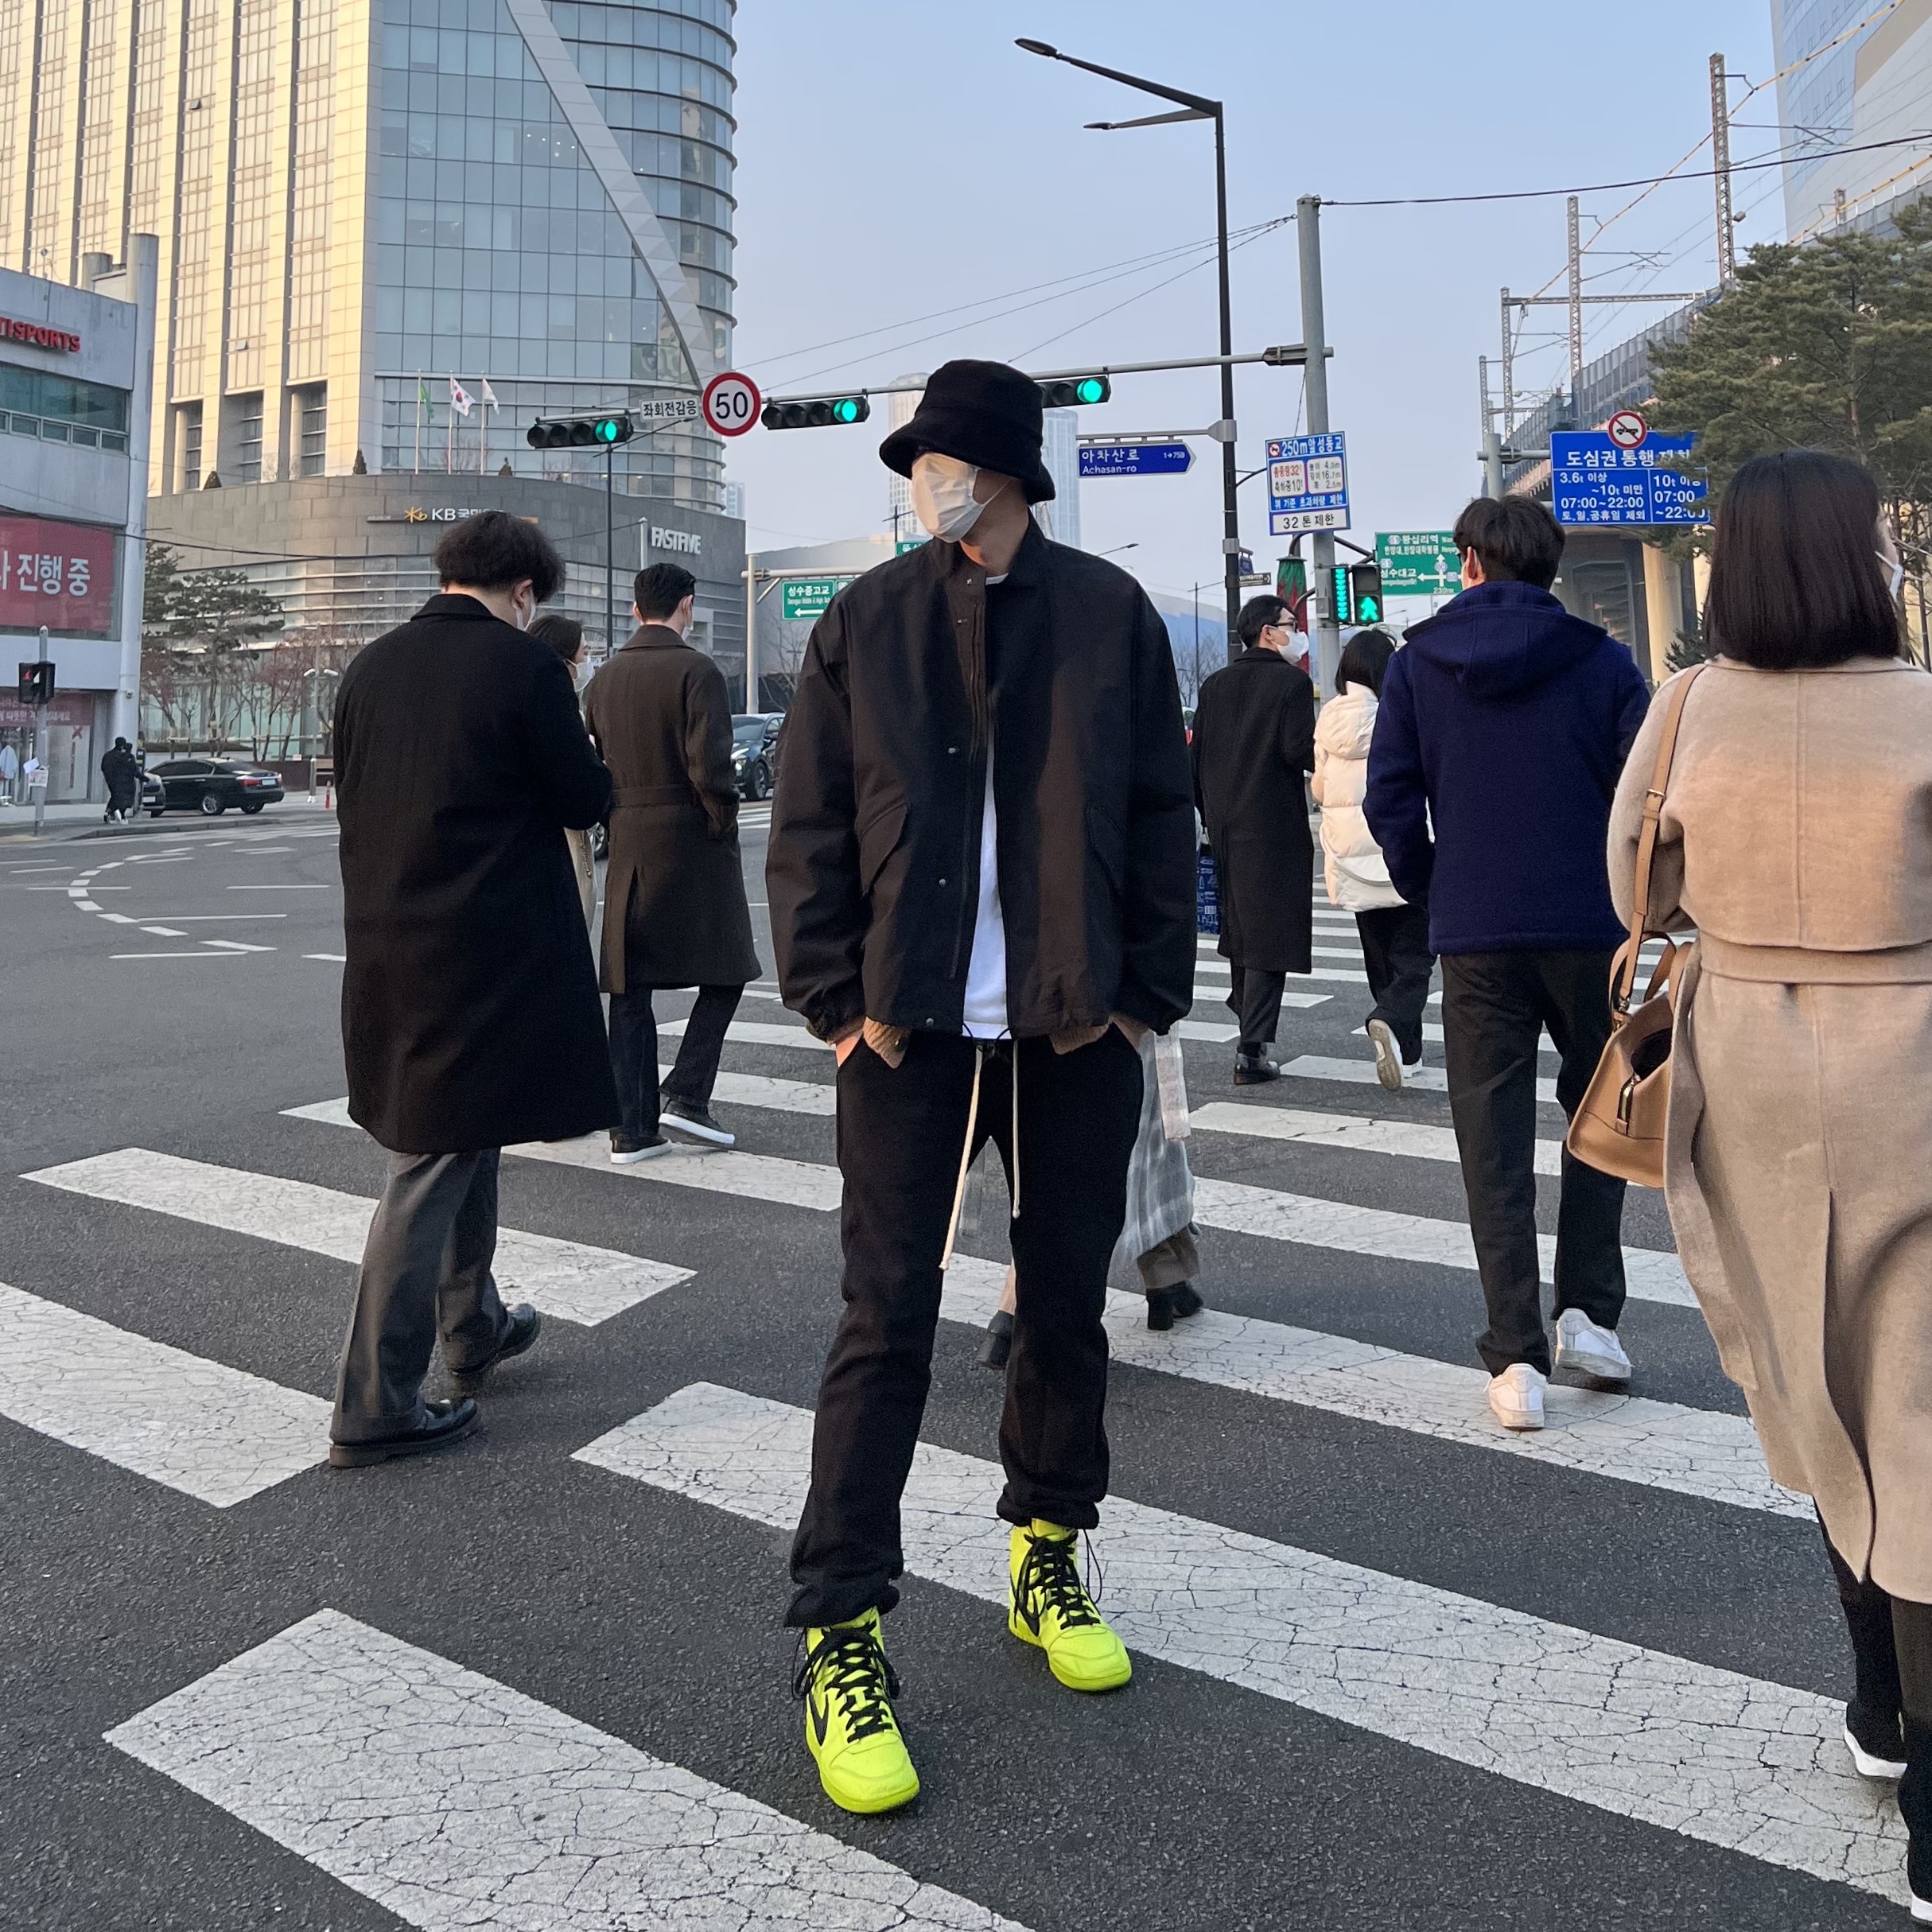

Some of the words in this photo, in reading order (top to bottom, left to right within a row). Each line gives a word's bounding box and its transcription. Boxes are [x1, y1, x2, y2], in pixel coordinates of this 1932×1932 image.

[643, 399, 698, 418] 좌회전감응
[716, 391, 748, 419] 50
[1082, 449, 1140, 464] 아차산로
[1566, 449, 1618, 468] 도심권
[1621, 449, 1655, 468] 통행
[1082, 465, 1137, 474] Achasan-ro
[1559, 472, 1584, 484] 3.6t
[1588, 472, 1607, 483] 이상
[1654, 475, 1676, 488] 10t
[1623, 484, 1643, 495] 미만
[1654, 490, 1696, 503] 07:00
[1561, 497, 1644, 509] 07:00~22:00
[1314, 513, 1334, 526] 제한
[1625, 509, 1646, 521] 제외
[1401, 534, 1439, 545] 왕십리역
[17, 554, 63, 595] 진행
[68, 558, 91, 597] 중
[1381, 568, 1417, 579] 성수대교
[787, 585, 830, 597] 성수중고교
